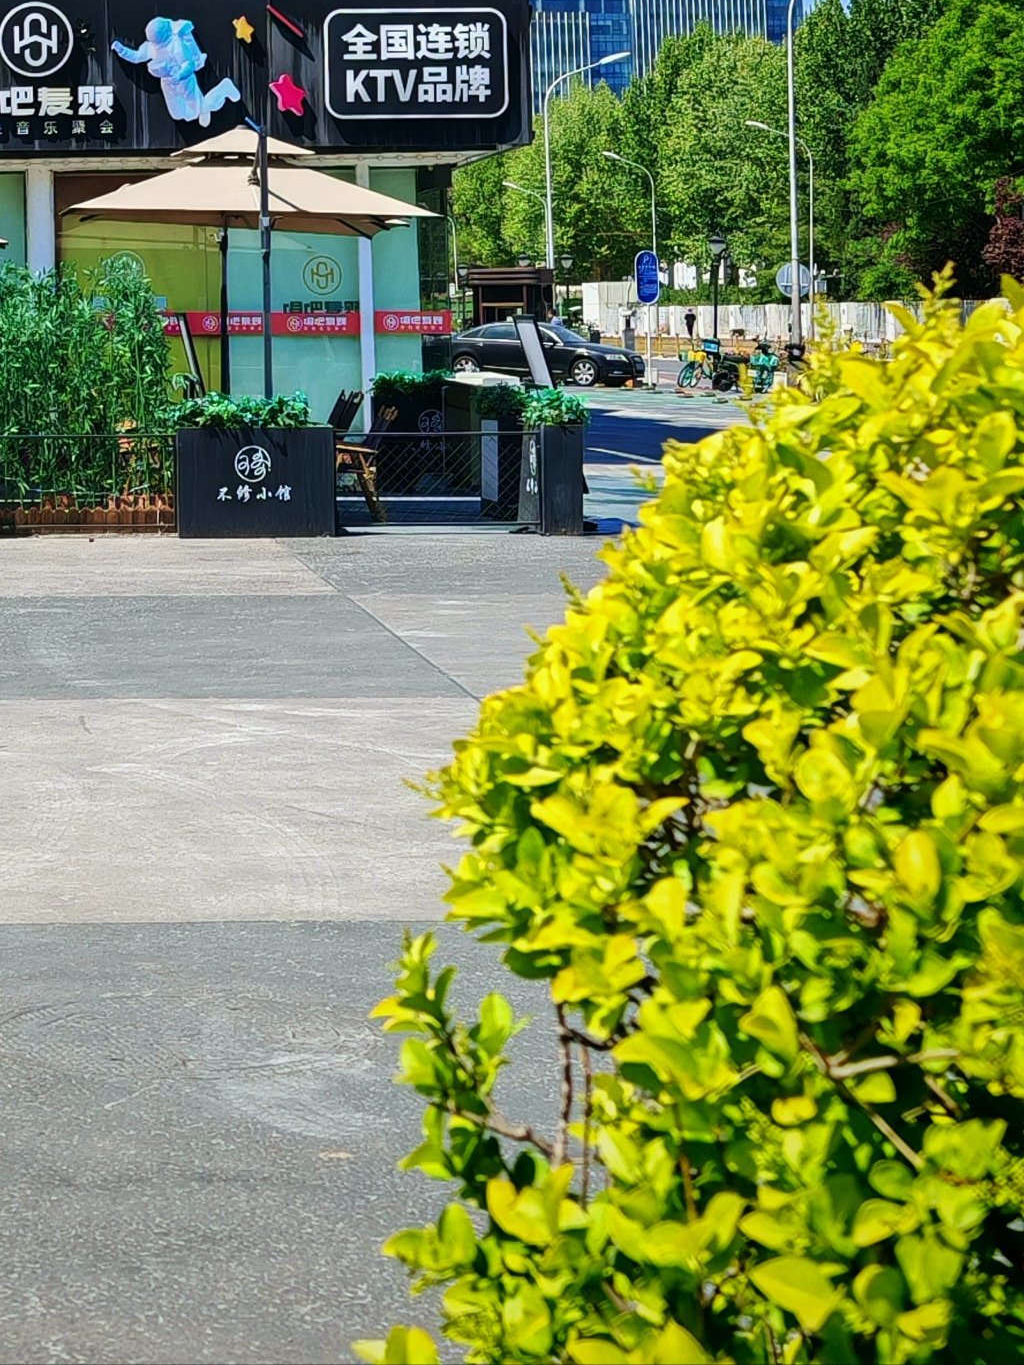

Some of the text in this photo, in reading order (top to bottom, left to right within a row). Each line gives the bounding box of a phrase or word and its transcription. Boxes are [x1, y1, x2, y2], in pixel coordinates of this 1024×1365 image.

[340, 22, 492, 61] 全国连锁
[345, 65, 492, 103] KTV品牌
